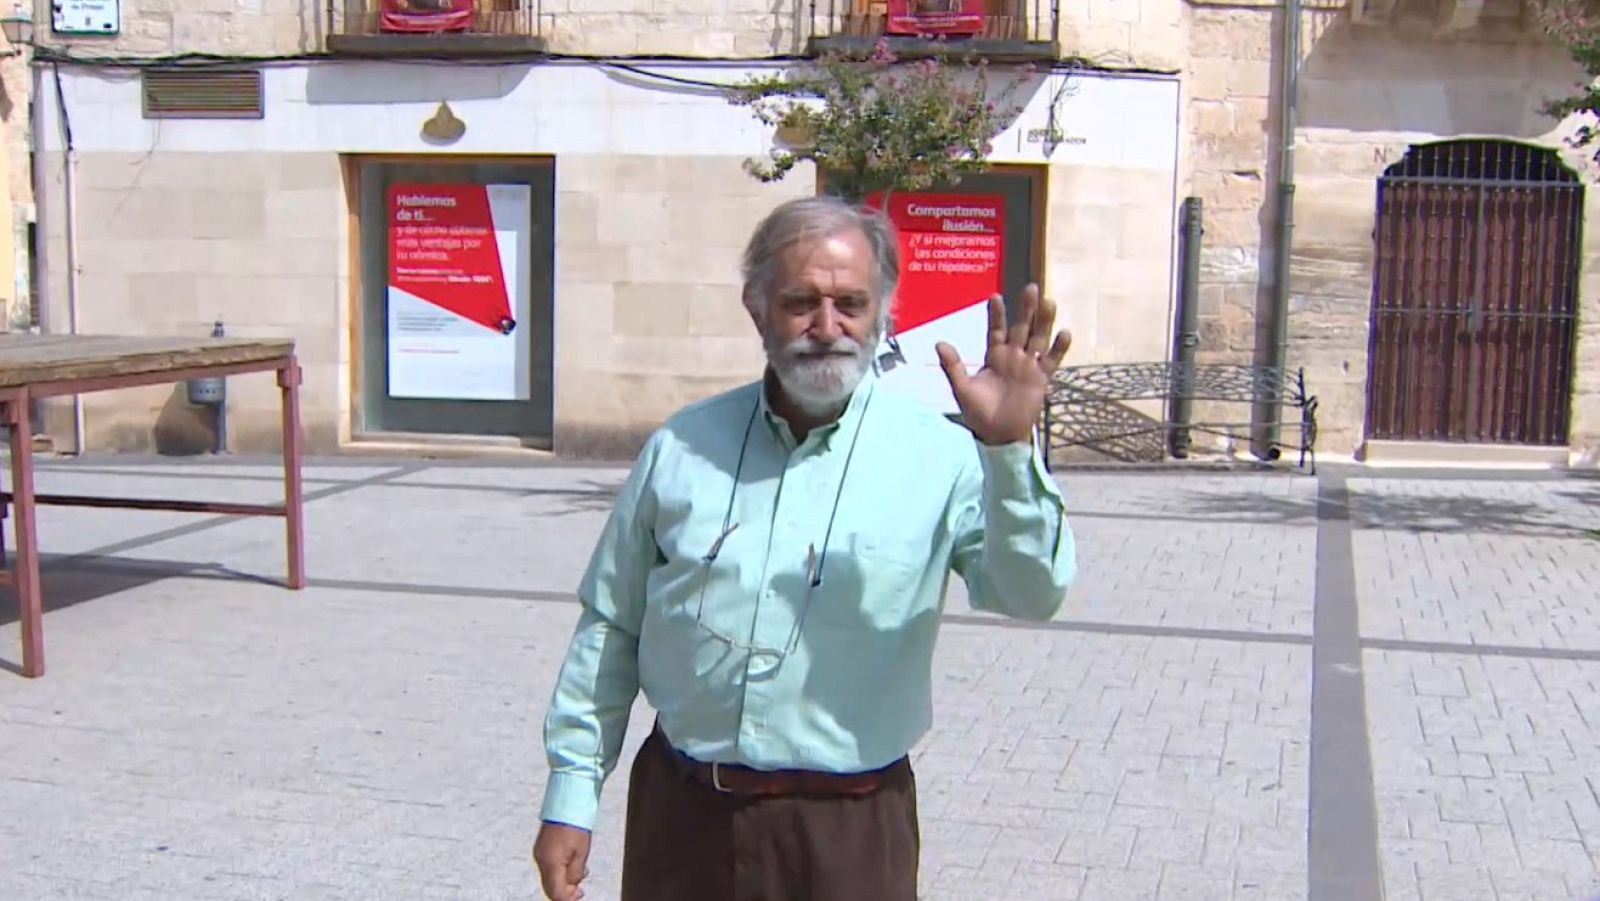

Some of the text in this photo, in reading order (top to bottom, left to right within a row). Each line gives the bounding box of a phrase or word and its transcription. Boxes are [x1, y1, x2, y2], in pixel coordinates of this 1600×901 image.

[396, 195, 457, 208] Hablemos
[396, 209, 412, 221] de
[907, 203, 996, 219] Compartamos
[463, 239, 482, 251] por
[934, 235, 996, 249] mejoramos
[914, 248, 996, 260] las condiciones
[908, 260, 922, 272] de
[923, 262, 936, 272] tu
